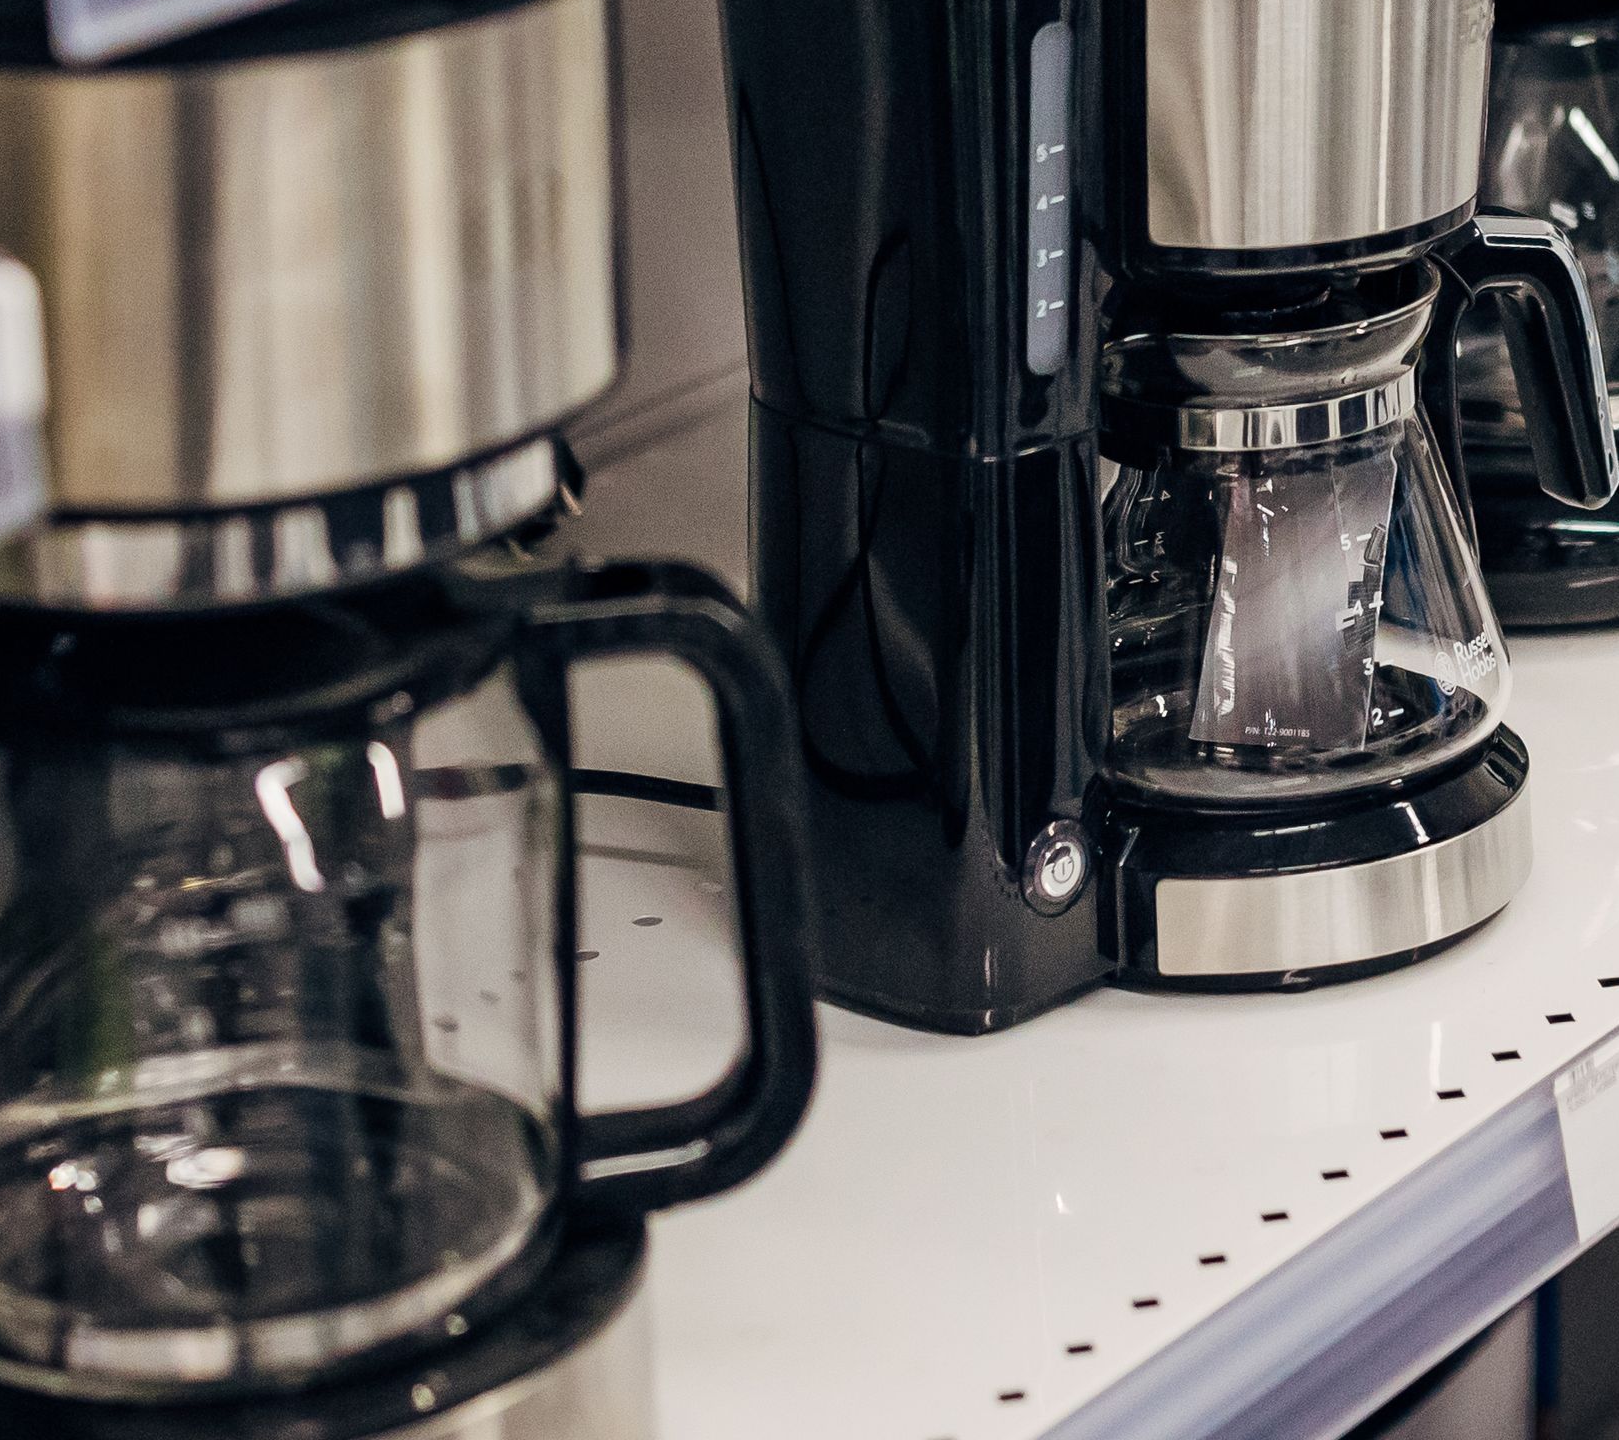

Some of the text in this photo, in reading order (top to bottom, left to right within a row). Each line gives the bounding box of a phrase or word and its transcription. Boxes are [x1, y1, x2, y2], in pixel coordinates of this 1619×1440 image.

[1036, 194, 1048, 211] 4
[1036, 248, 1048, 268] 3
[1036, 299, 1048, 318] 2
[1340, 533, 1352, 551] 5
[1352, 599, 1364, 617] 4
[1362, 657, 1374, 676] 3
[1460, 652, 1497, 687] Hobbs
[1371, 707, 1384, 726] 2
